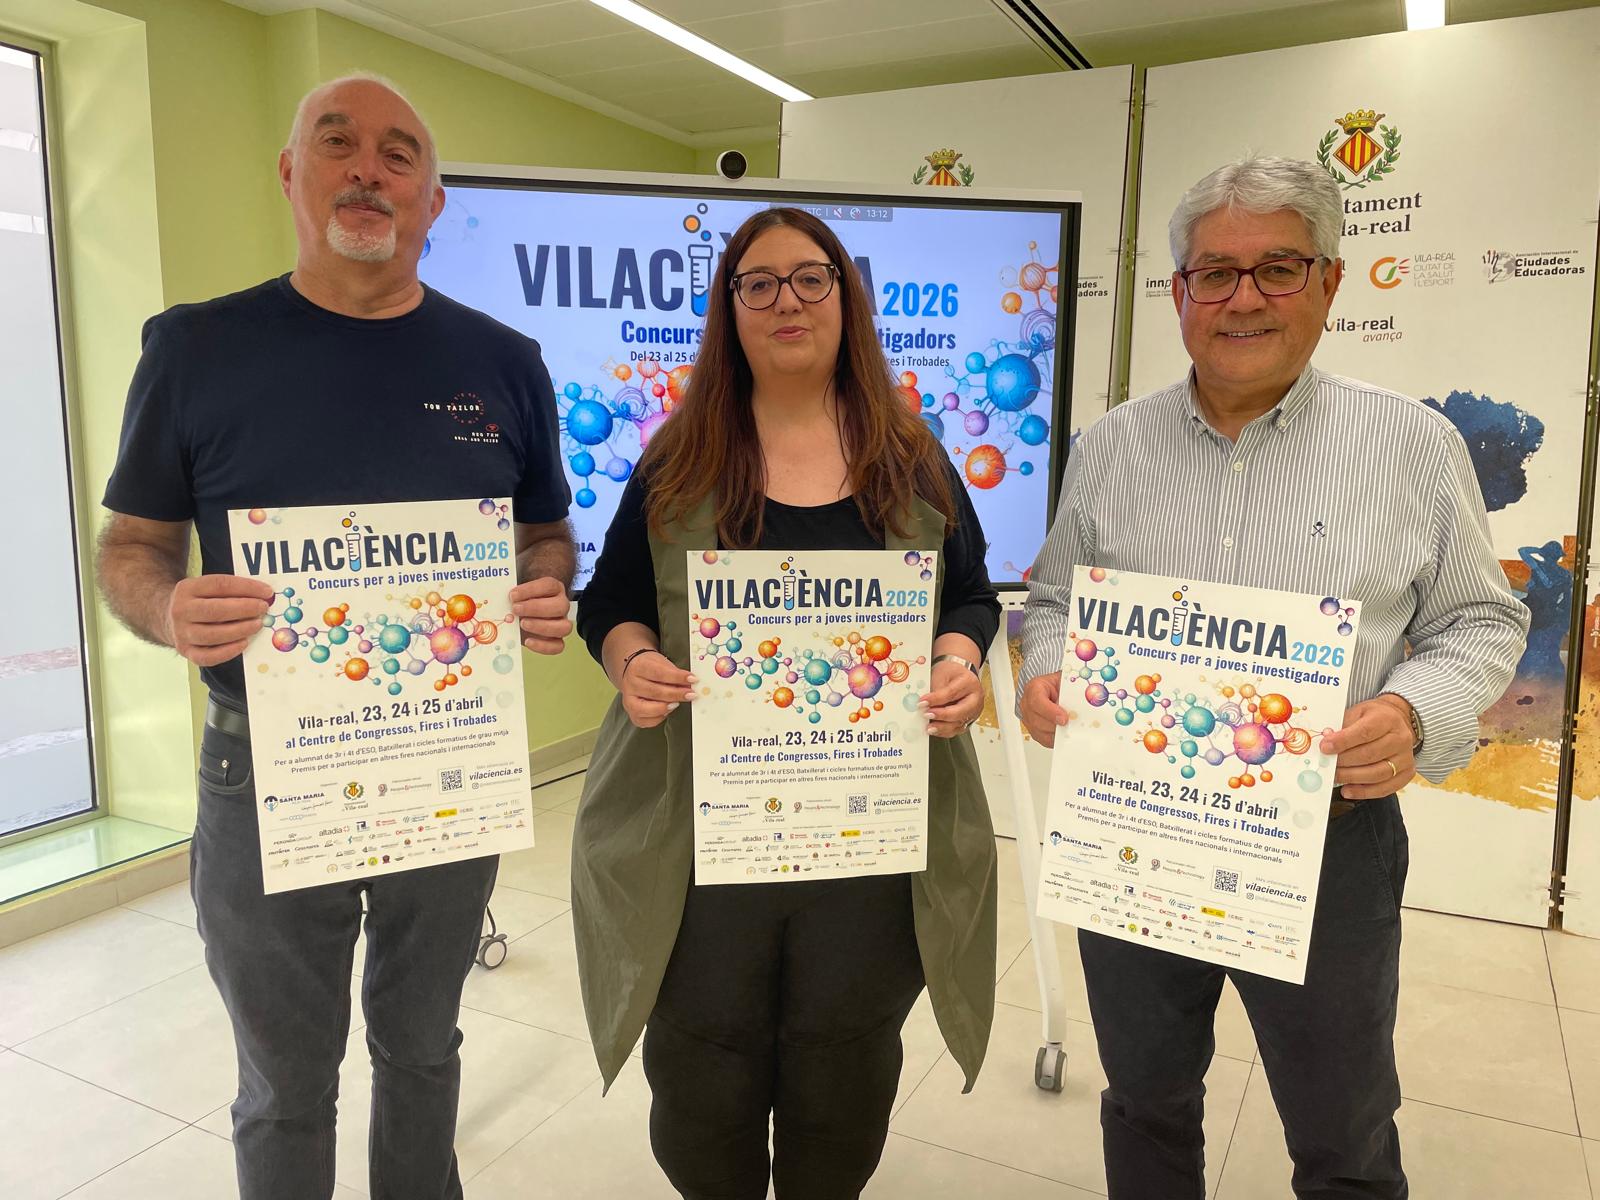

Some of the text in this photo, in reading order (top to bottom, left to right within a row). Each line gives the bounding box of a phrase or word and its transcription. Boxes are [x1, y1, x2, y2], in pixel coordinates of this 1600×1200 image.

[866, 210, 888, 218] 13:12
[1414, 252, 1456, 263] VILA-REAL
[1515, 257, 1570, 267] Ciudades
[1515, 267, 1585, 277] Educadoras
[882, 282, 958, 318] 2026
[622, 320, 703, 344] Concurs
[1363, 331, 1402, 342] avança
[631, 351, 646, 361] Del
[649, 352, 661, 362] 23
[664, 351, 672, 362] al
[675, 352, 687, 362] 25
[907, 356, 949, 366] Trobades
[464, 541, 509, 562] 2026
[308, 565, 509, 590] Concurs per a joves investigadors
[886, 590, 928, 607] 2026
[748, 611, 926, 626] Concurs per a joves investigadors
[1128, 642, 1339, 686] Concurs per a joves investigadors
[1291, 641, 1345, 668] 2026
[298, 695, 482, 729] Vila-real, 23, 24 i 25 d'abril
[285, 713, 496, 748] al Centre de Congressos, Fires i Trobades
[731, 729, 891, 747] Vila-real, 23, 24 i 25 d'abril
[719, 746, 902, 763] al Centre de Congressos, Fires i Trobades
[469, 767, 522, 780] vilaciencia.es
[1092, 770, 1278, 819] Vila-real, 23, 24 i 25 d'abril
[1077, 786, 1289, 839] al Centre de Congressos, Fires i Trobades
[1245, 882, 1307, 902] vilaciencia.es
